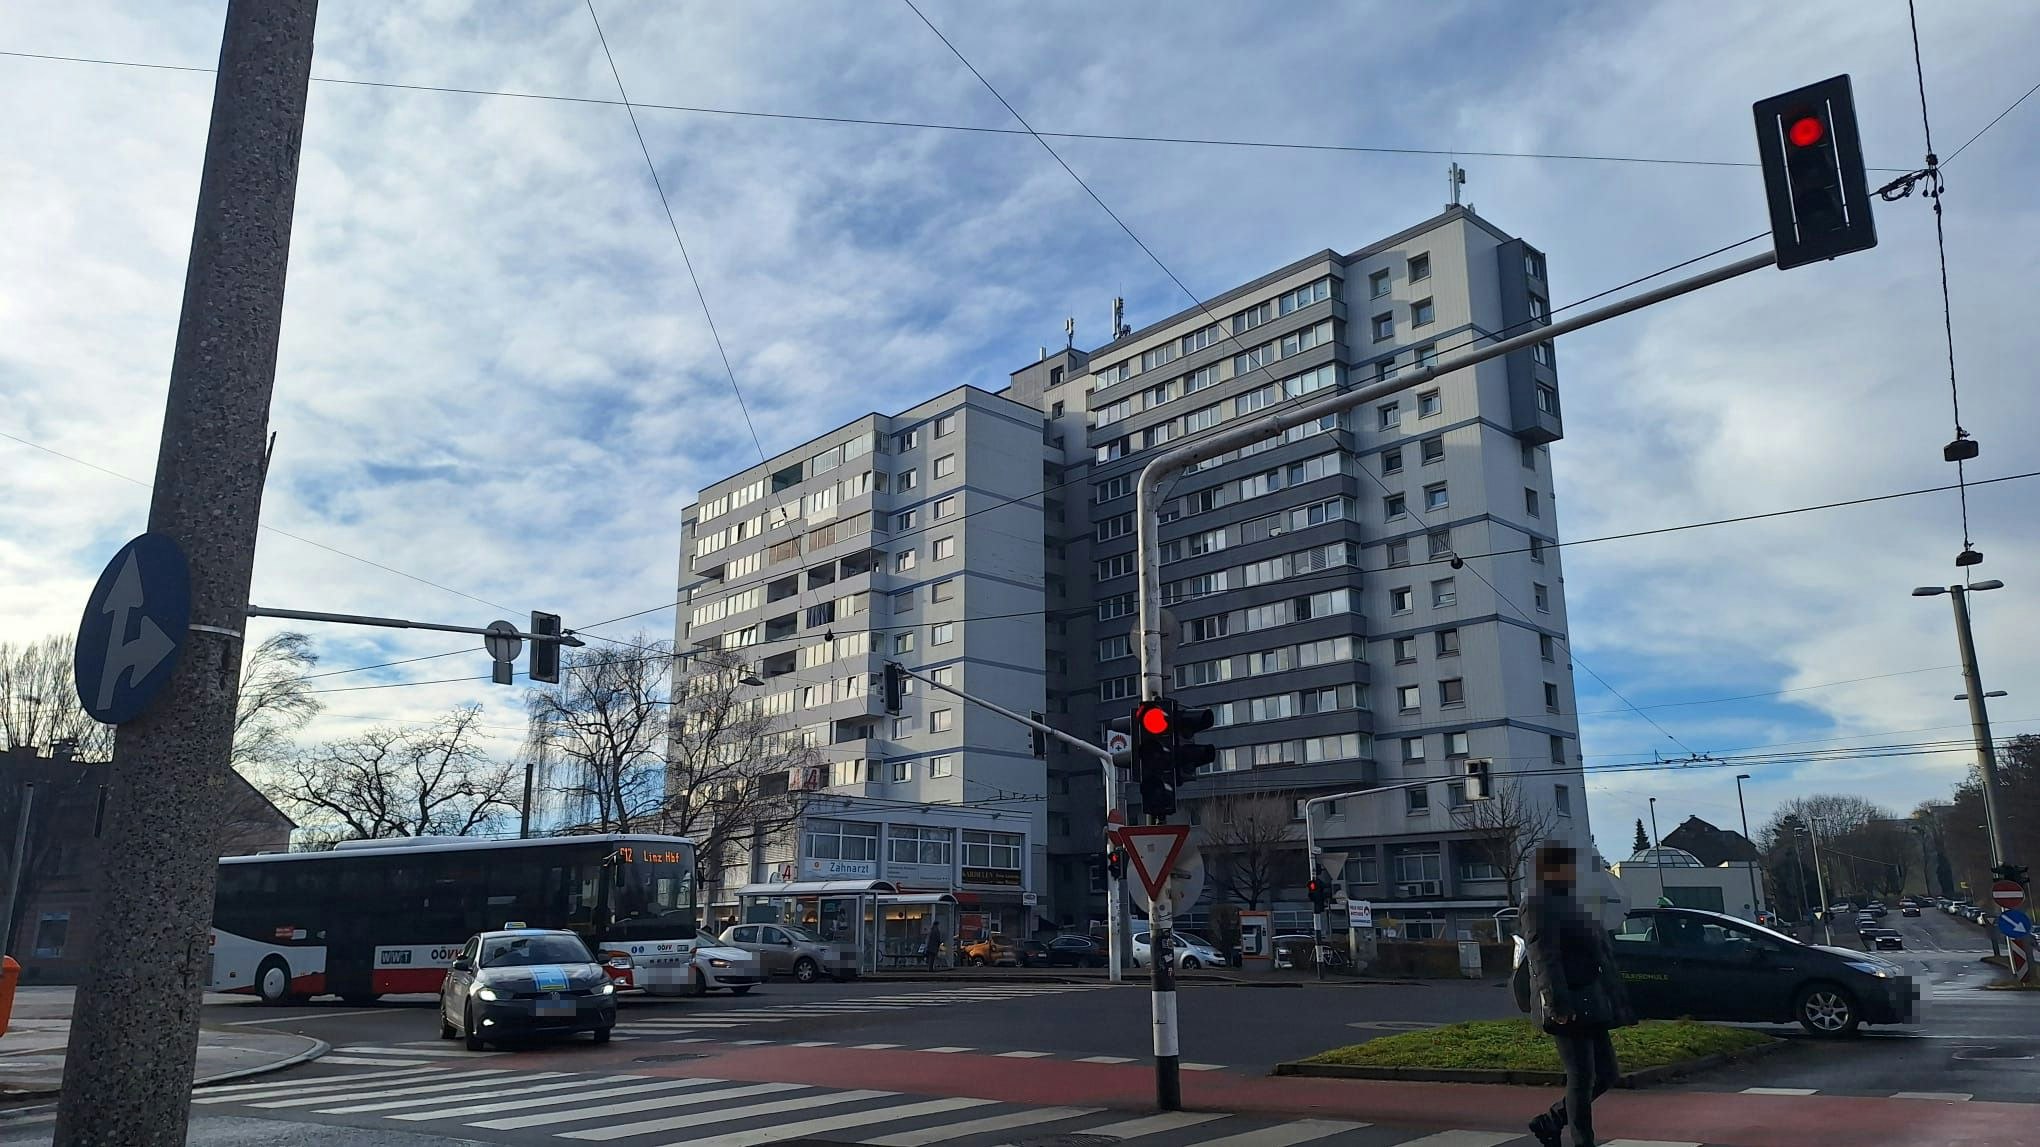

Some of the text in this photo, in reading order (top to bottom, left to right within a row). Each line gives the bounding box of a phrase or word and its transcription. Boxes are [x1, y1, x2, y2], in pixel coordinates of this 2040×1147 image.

[643, 849, 680, 863] Linz Hbf
[782, 864, 791, 880] A
[830, 862, 869, 873] Zahnarzt
[381, 950, 411, 964] WWT
